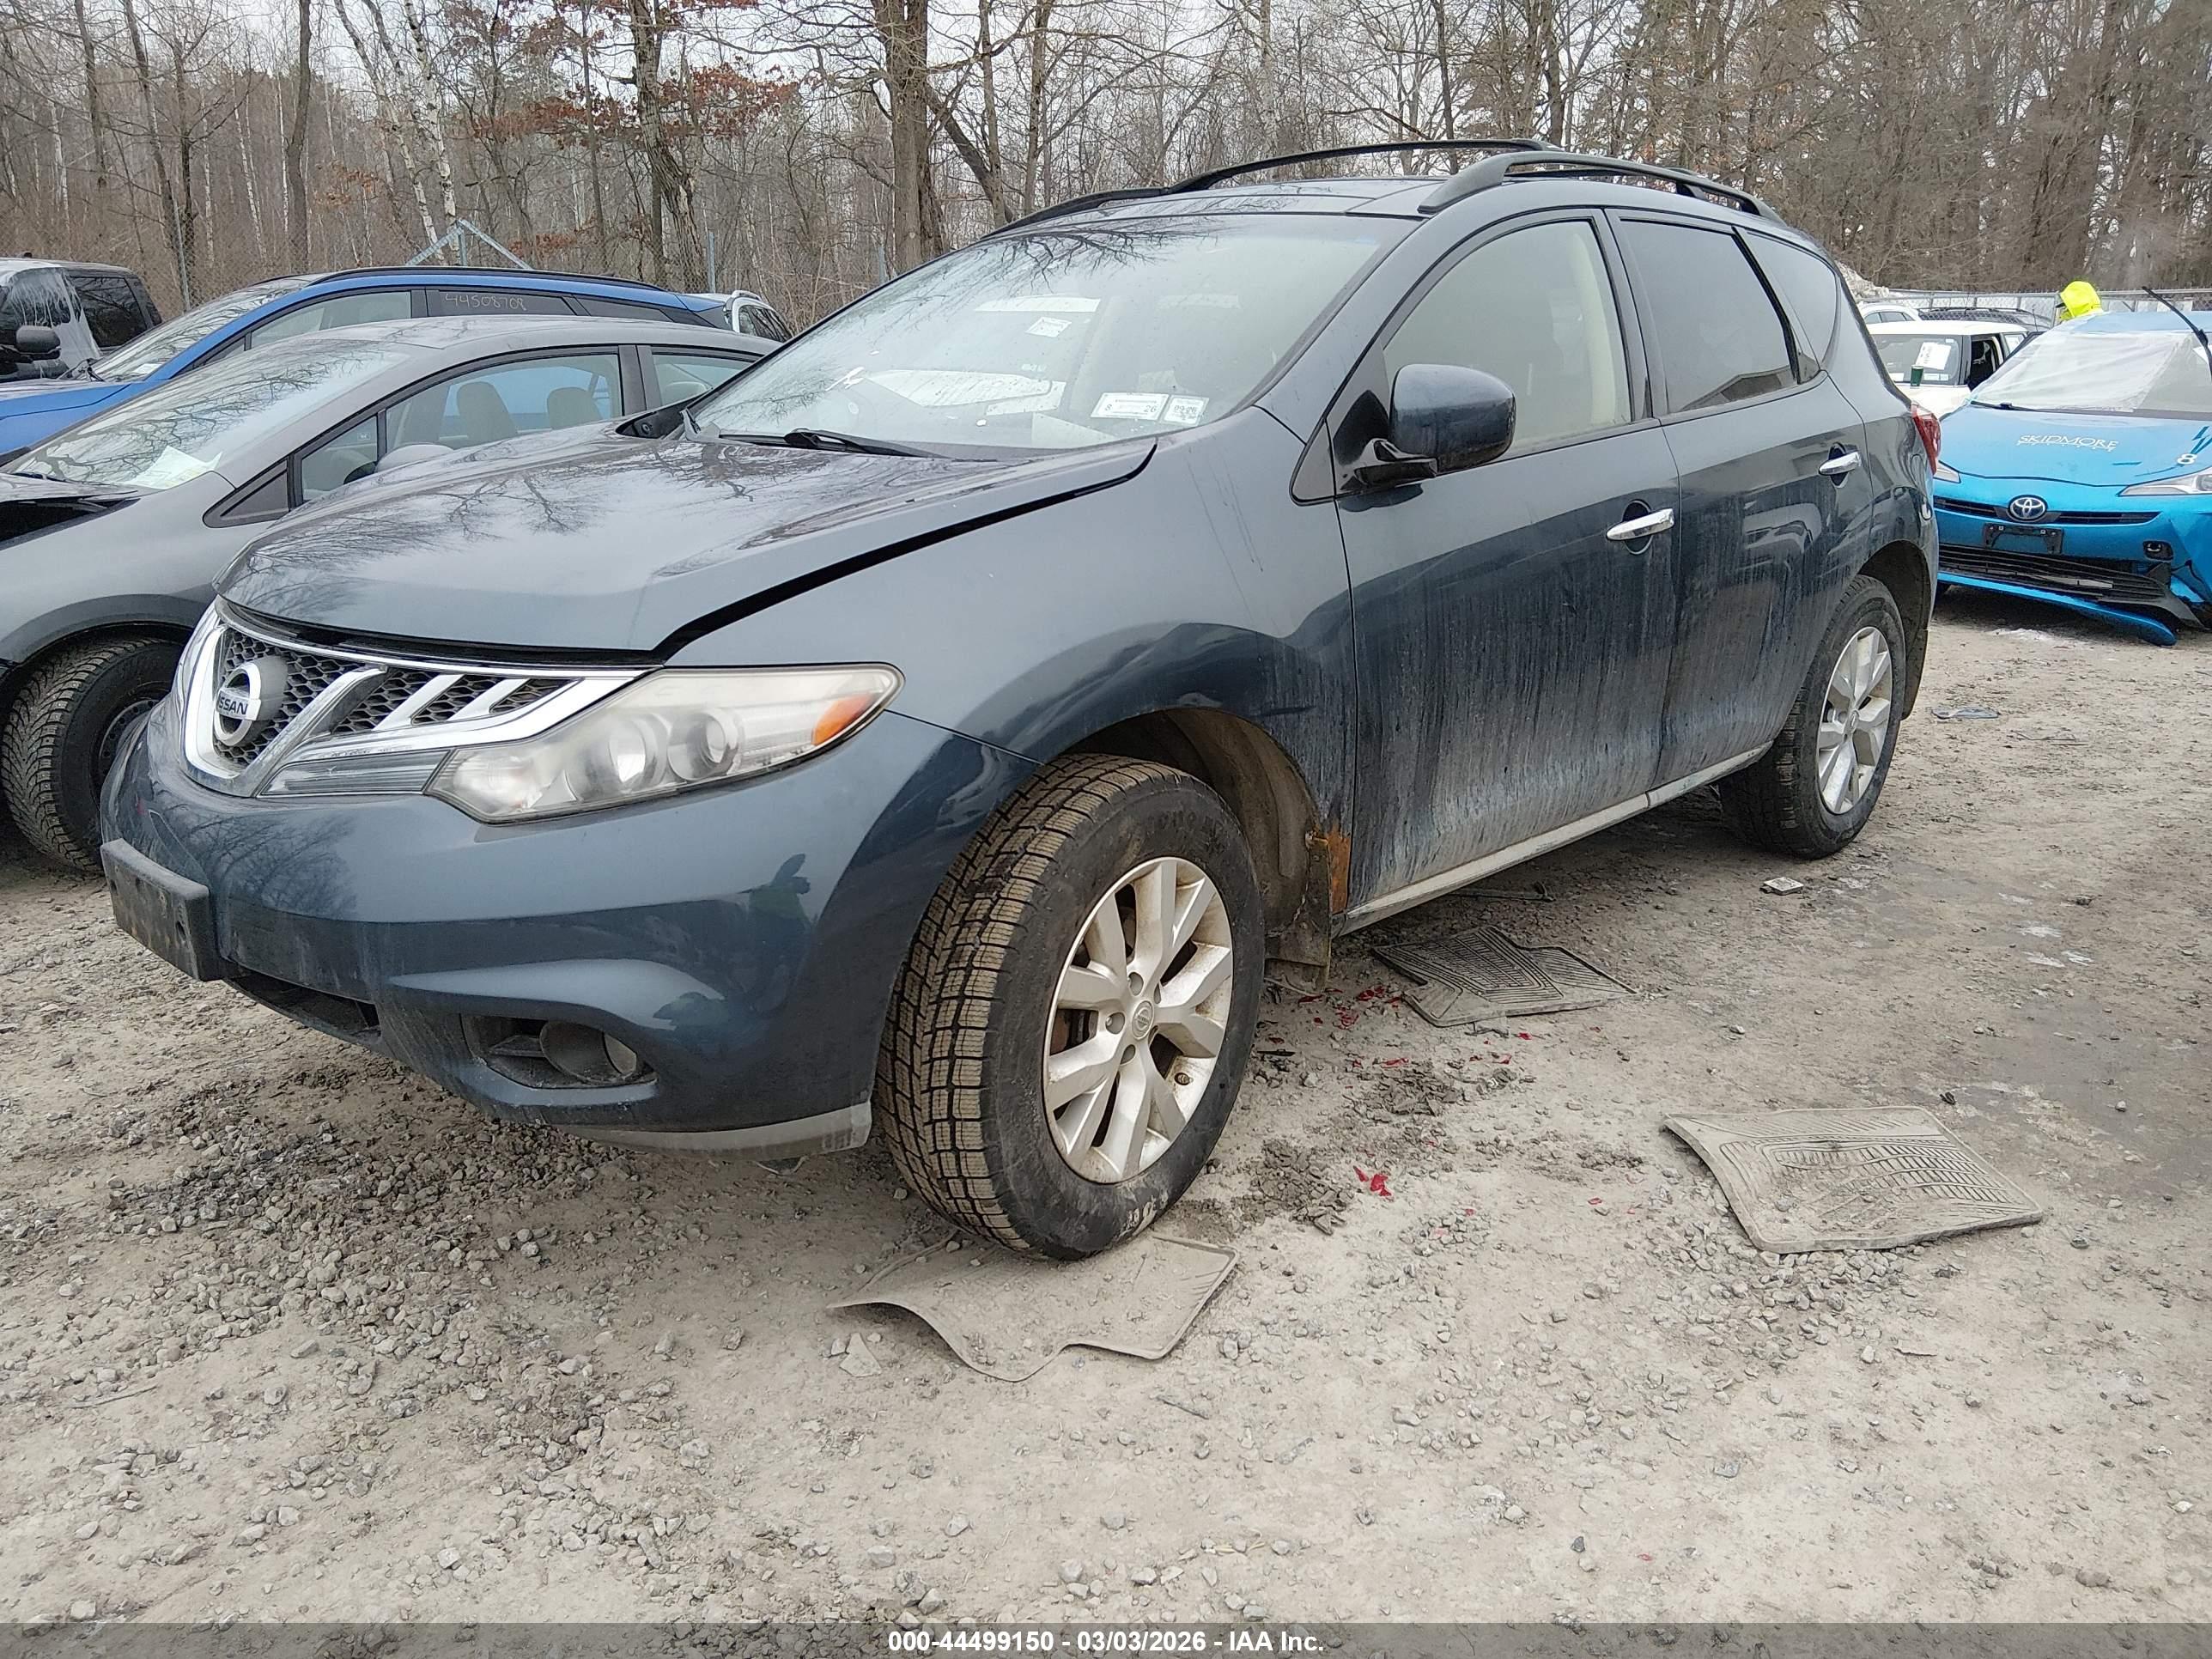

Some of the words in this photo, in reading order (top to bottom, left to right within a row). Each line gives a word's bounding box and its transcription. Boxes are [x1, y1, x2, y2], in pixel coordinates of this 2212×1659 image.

[2018, 434, 2118, 451] SKIDMORE
[2177, 453, 2198, 465] 8
[218, 696, 249, 715] SSAN
